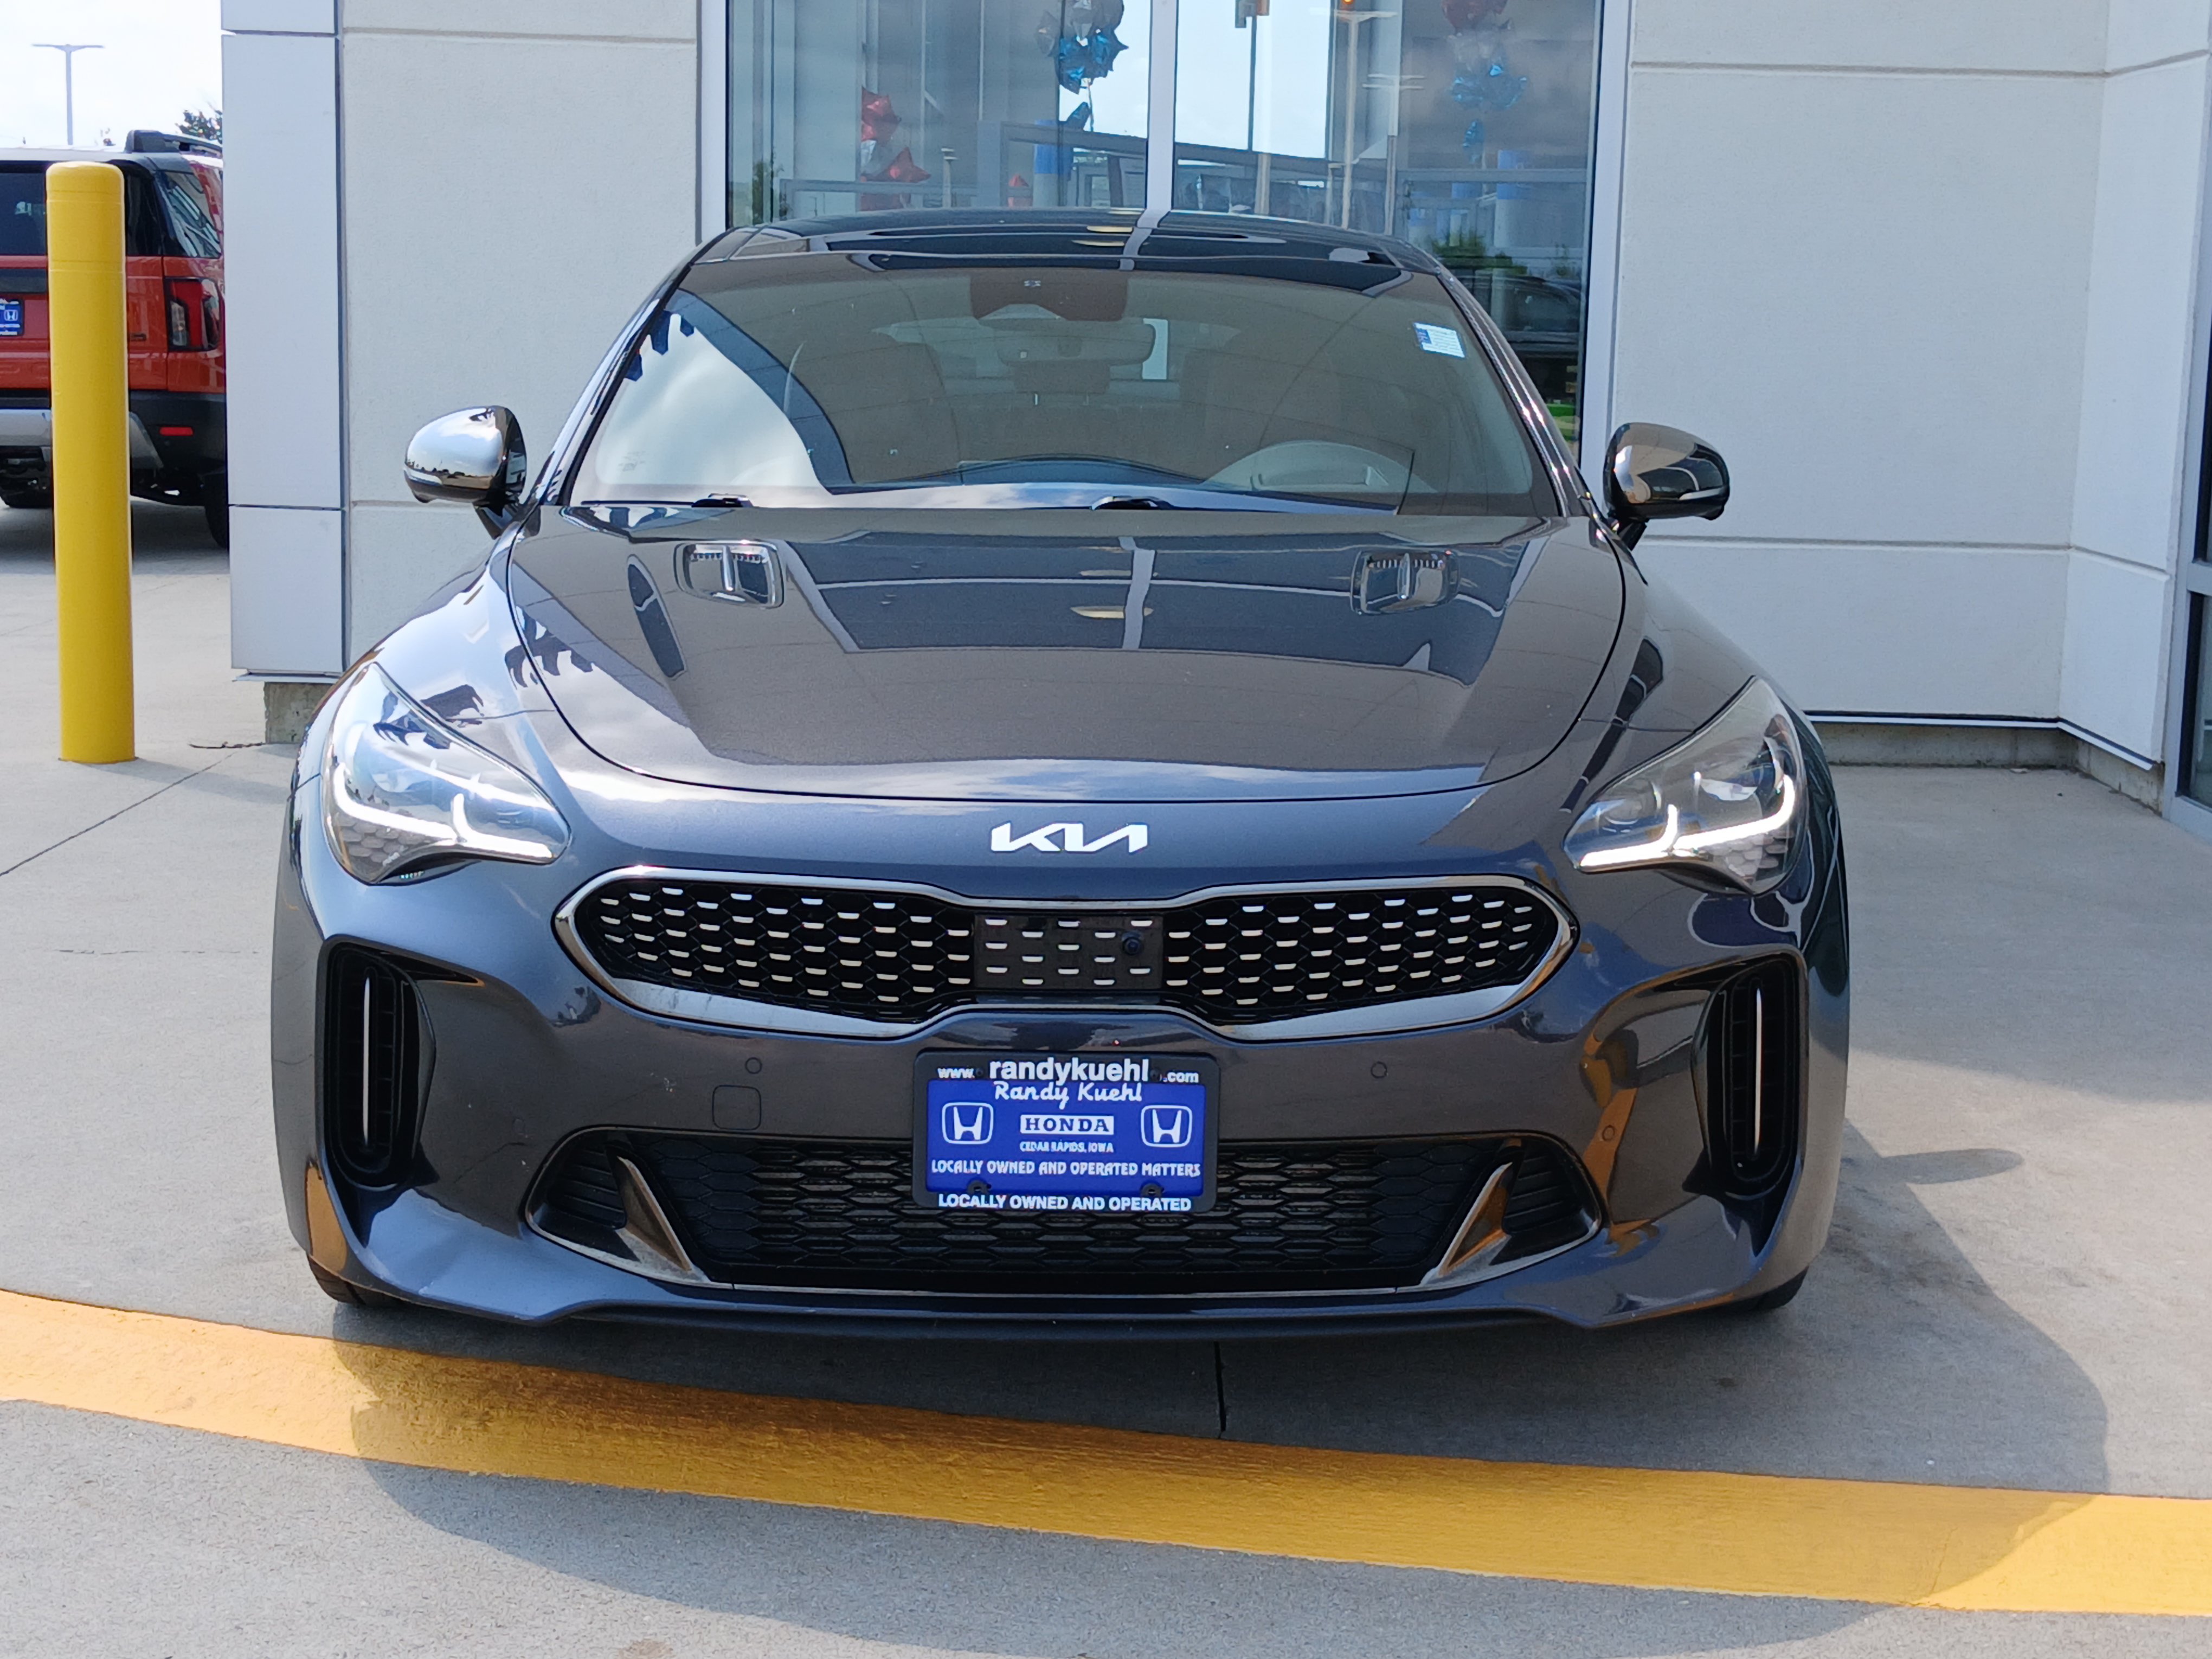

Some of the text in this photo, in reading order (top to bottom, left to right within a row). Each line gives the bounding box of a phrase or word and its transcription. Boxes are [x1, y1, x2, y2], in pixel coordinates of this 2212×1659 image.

[937, 1068, 975, 1078] www.
[989, 1057, 1149, 1086] randykuehl
[993, 1081, 1142, 1110] Randy Kuehl
[1025, 1117, 1110, 1132] HONDA
[1088, 1142, 1114, 1153] IOWA
[931, 1160, 1201, 1178] LOCALLY OWNED AND OPERATED MATTERS
[938, 1193, 1192, 1211] LOCALLY OWNED AND OPERATED
